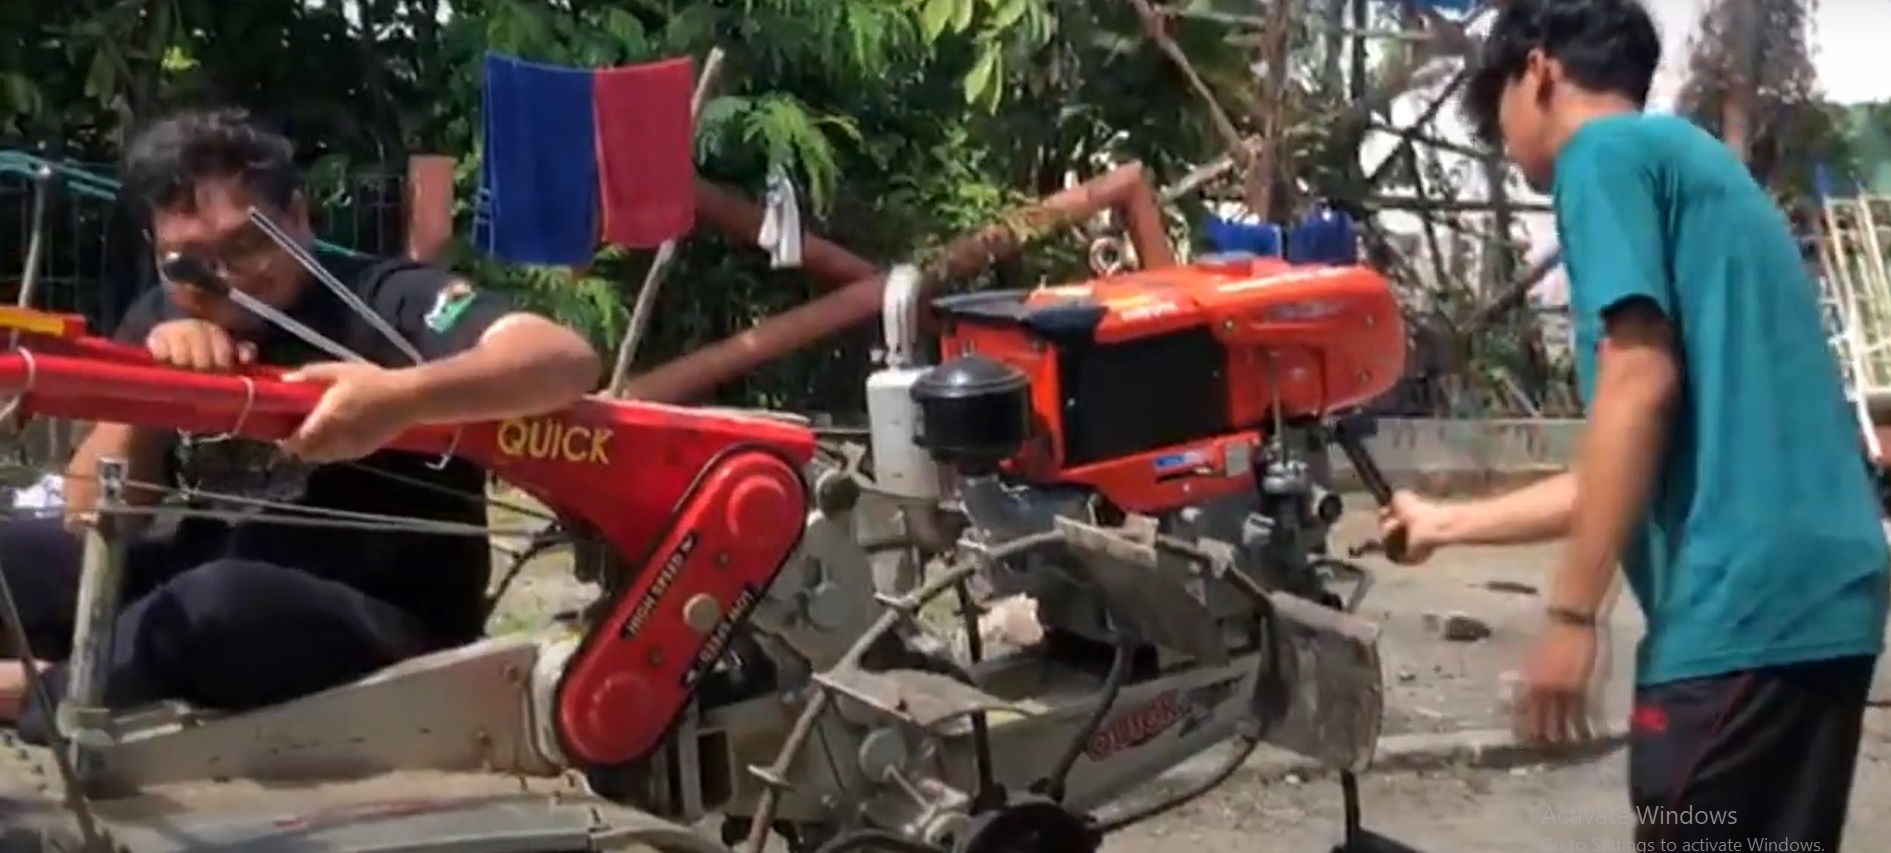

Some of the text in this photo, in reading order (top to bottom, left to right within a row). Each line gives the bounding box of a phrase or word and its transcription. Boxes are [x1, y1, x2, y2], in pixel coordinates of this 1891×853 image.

[498, 418, 614, 464] QUICK
[626, 554, 684, 637] HIGH SPEED
